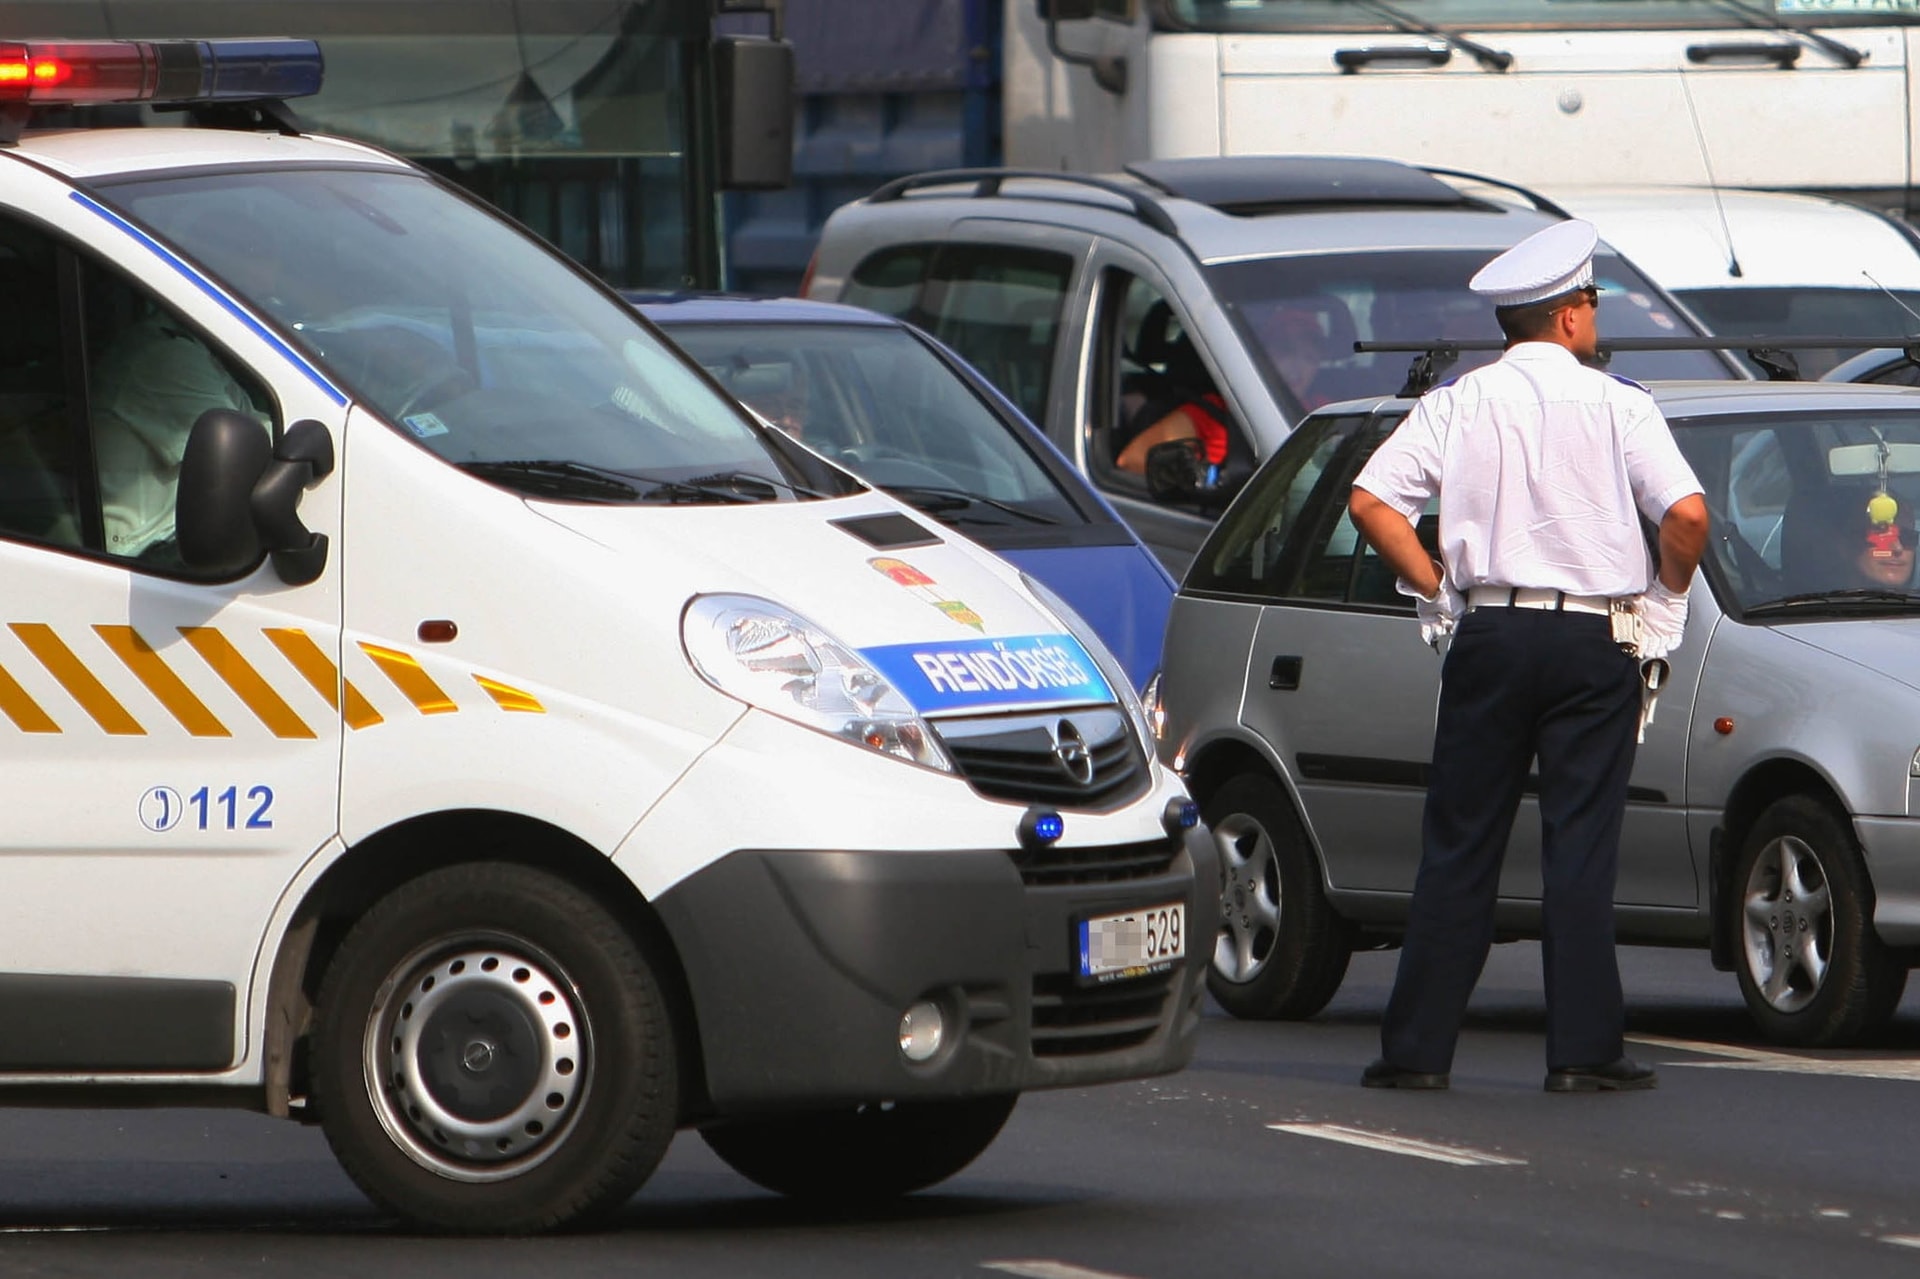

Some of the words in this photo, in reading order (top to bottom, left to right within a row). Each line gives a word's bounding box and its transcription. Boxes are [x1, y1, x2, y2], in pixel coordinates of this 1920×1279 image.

[912, 639, 1090, 693] RENDŐRSÉG
[190, 786, 274, 830] 112
[1147, 908, 1180, 958] 529
